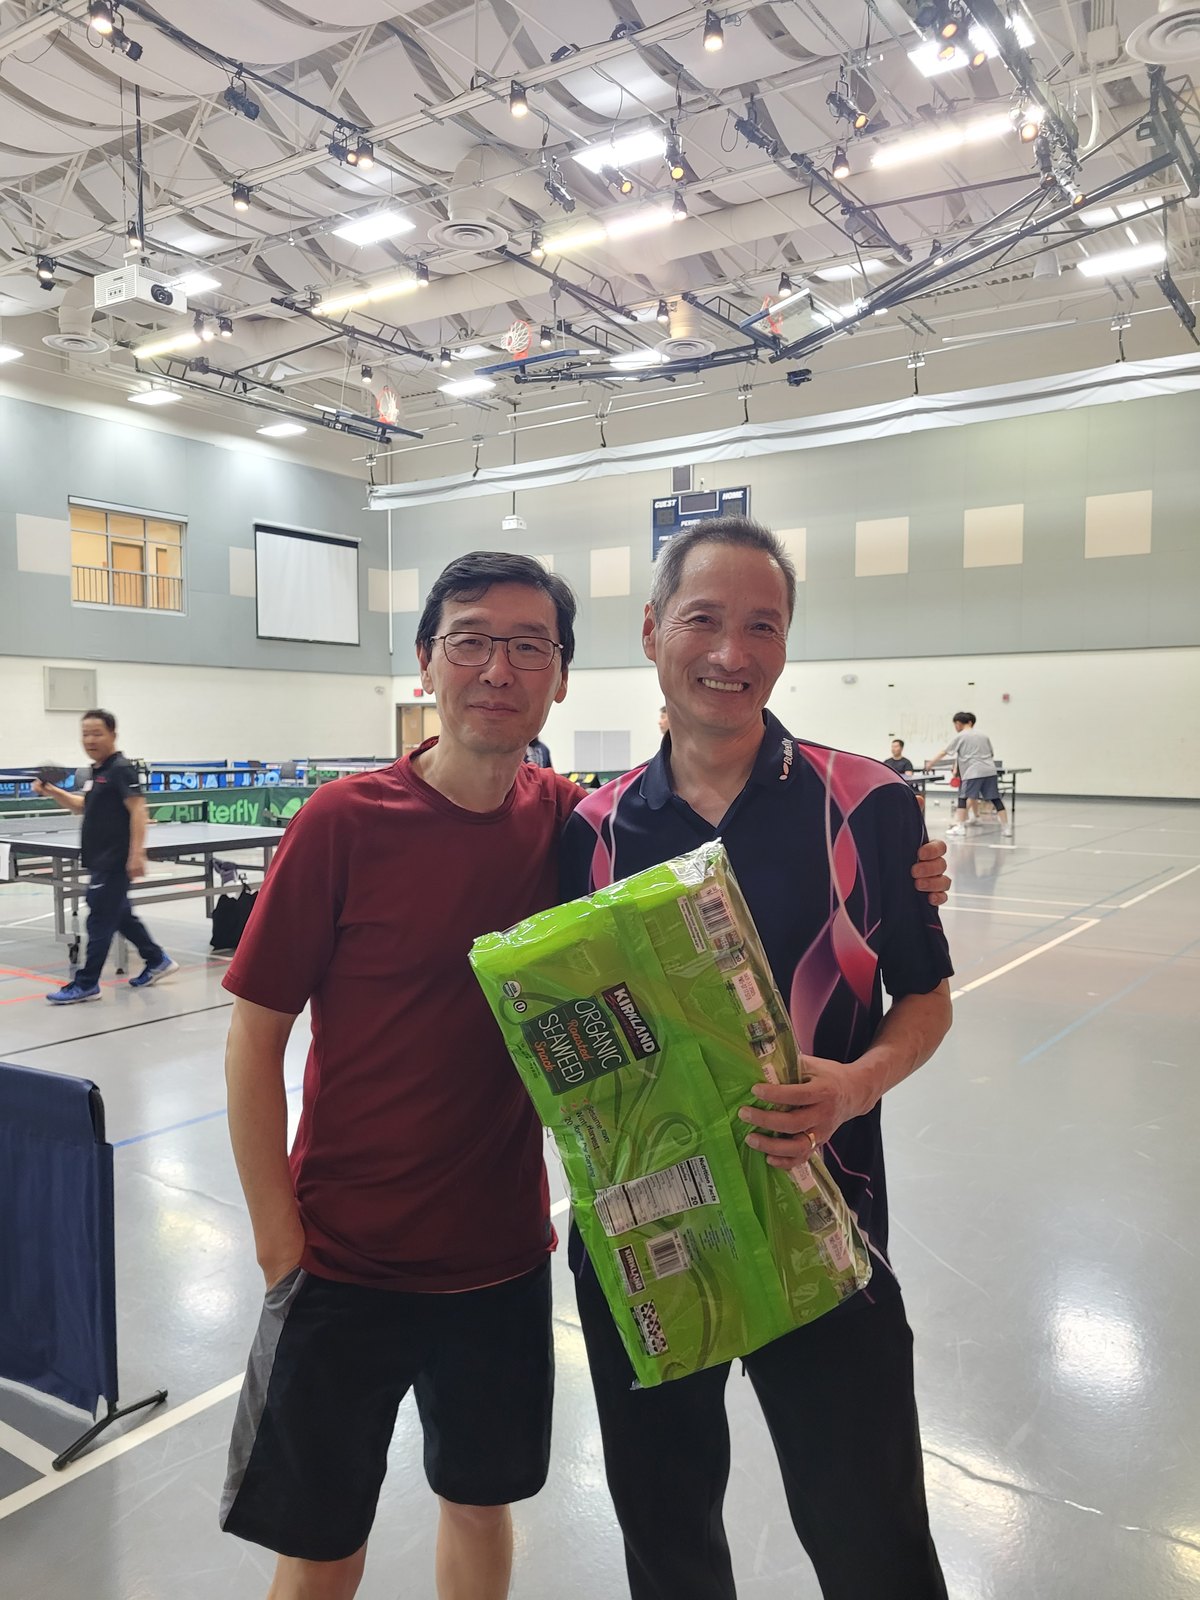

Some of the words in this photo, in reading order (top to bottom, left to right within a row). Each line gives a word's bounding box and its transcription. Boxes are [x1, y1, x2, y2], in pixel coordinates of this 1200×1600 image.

[654, 499, 677, 509] GUEST
[722, 490, 744, 500] HOME
[175, 799, 259, 824] Buterfly
[567, 1019, 594, 1062] Roasted
[574, 1000, 622, 1069] ORGANIC
[613, 988, 656, 1053] KIRKLAND
[534, 1041, 556, 1073] Snack
[538, 1013, 585, 1083] SEAWEED
[699, 1157, 711, 1184] Nutrition
[708, 1184, 717, 1202] Facts
[691, 1196, 699, 1206] 20
[624, 1248, 643, 1290] KIRKLAND
